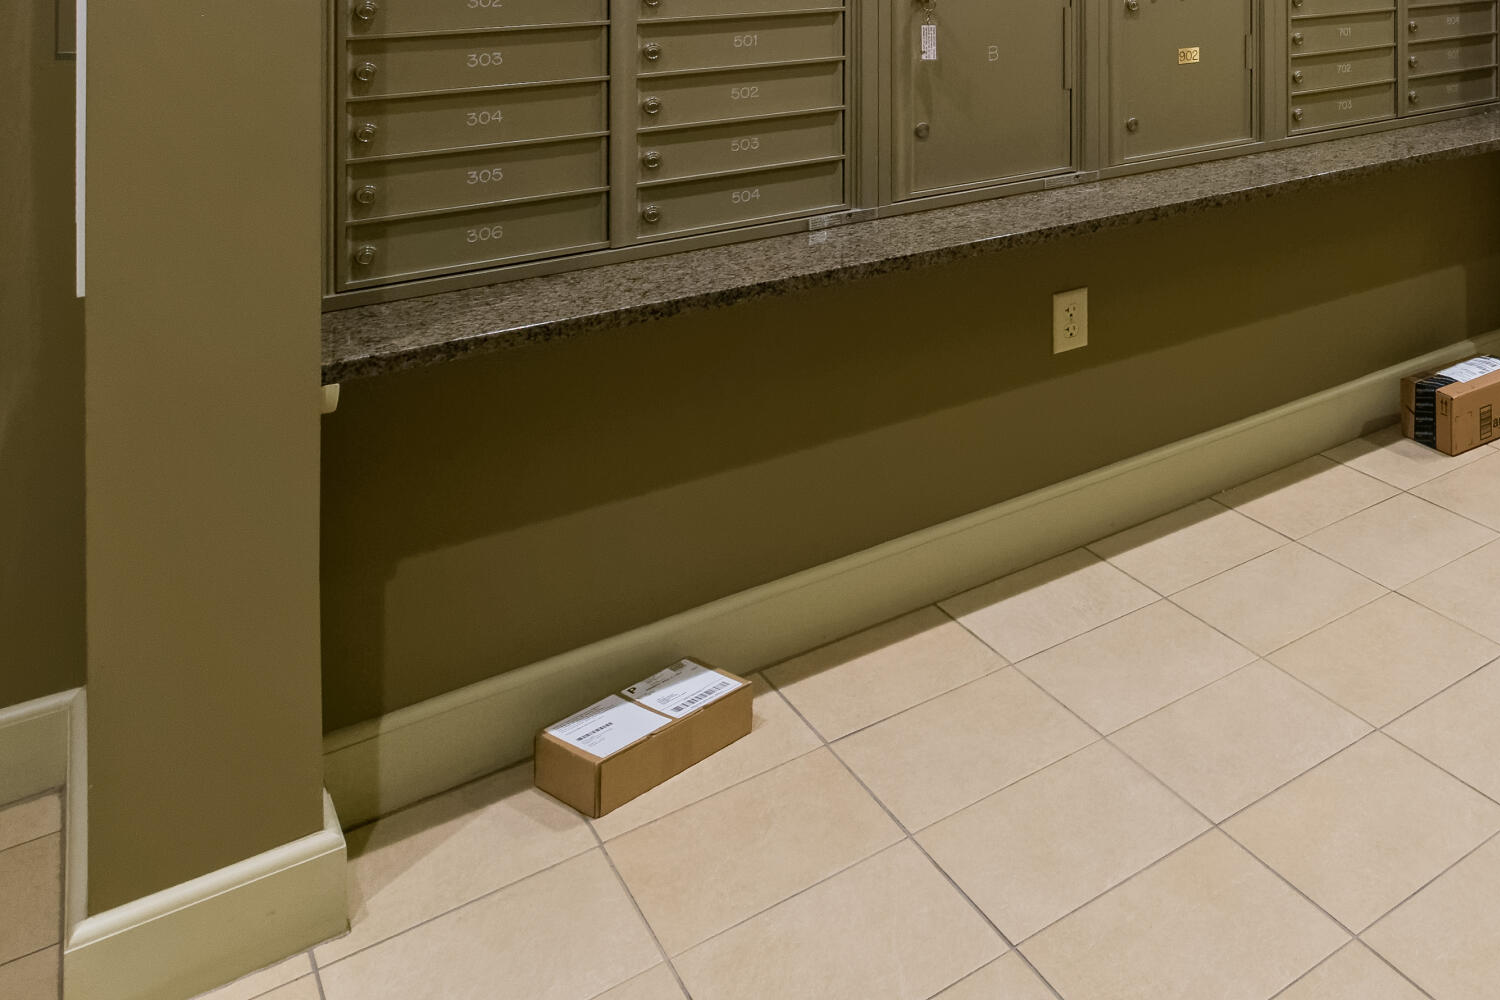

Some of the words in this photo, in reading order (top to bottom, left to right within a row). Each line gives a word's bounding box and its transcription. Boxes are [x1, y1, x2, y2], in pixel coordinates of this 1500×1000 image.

[733, 34, 758, 48] 501
[466, 52, 503, 68] 303
[987, 45, 999, 62] B
[1178, 50, 1199, 63] 902
[730, 86, 759, 99] 502
[466, 110, 503, 126] 304
[730, 137, 760, 151] 503
[466, 168, 503, 184] 305
[731, 188, 761, 203] 504
[466, 226, 503, 243] 306
